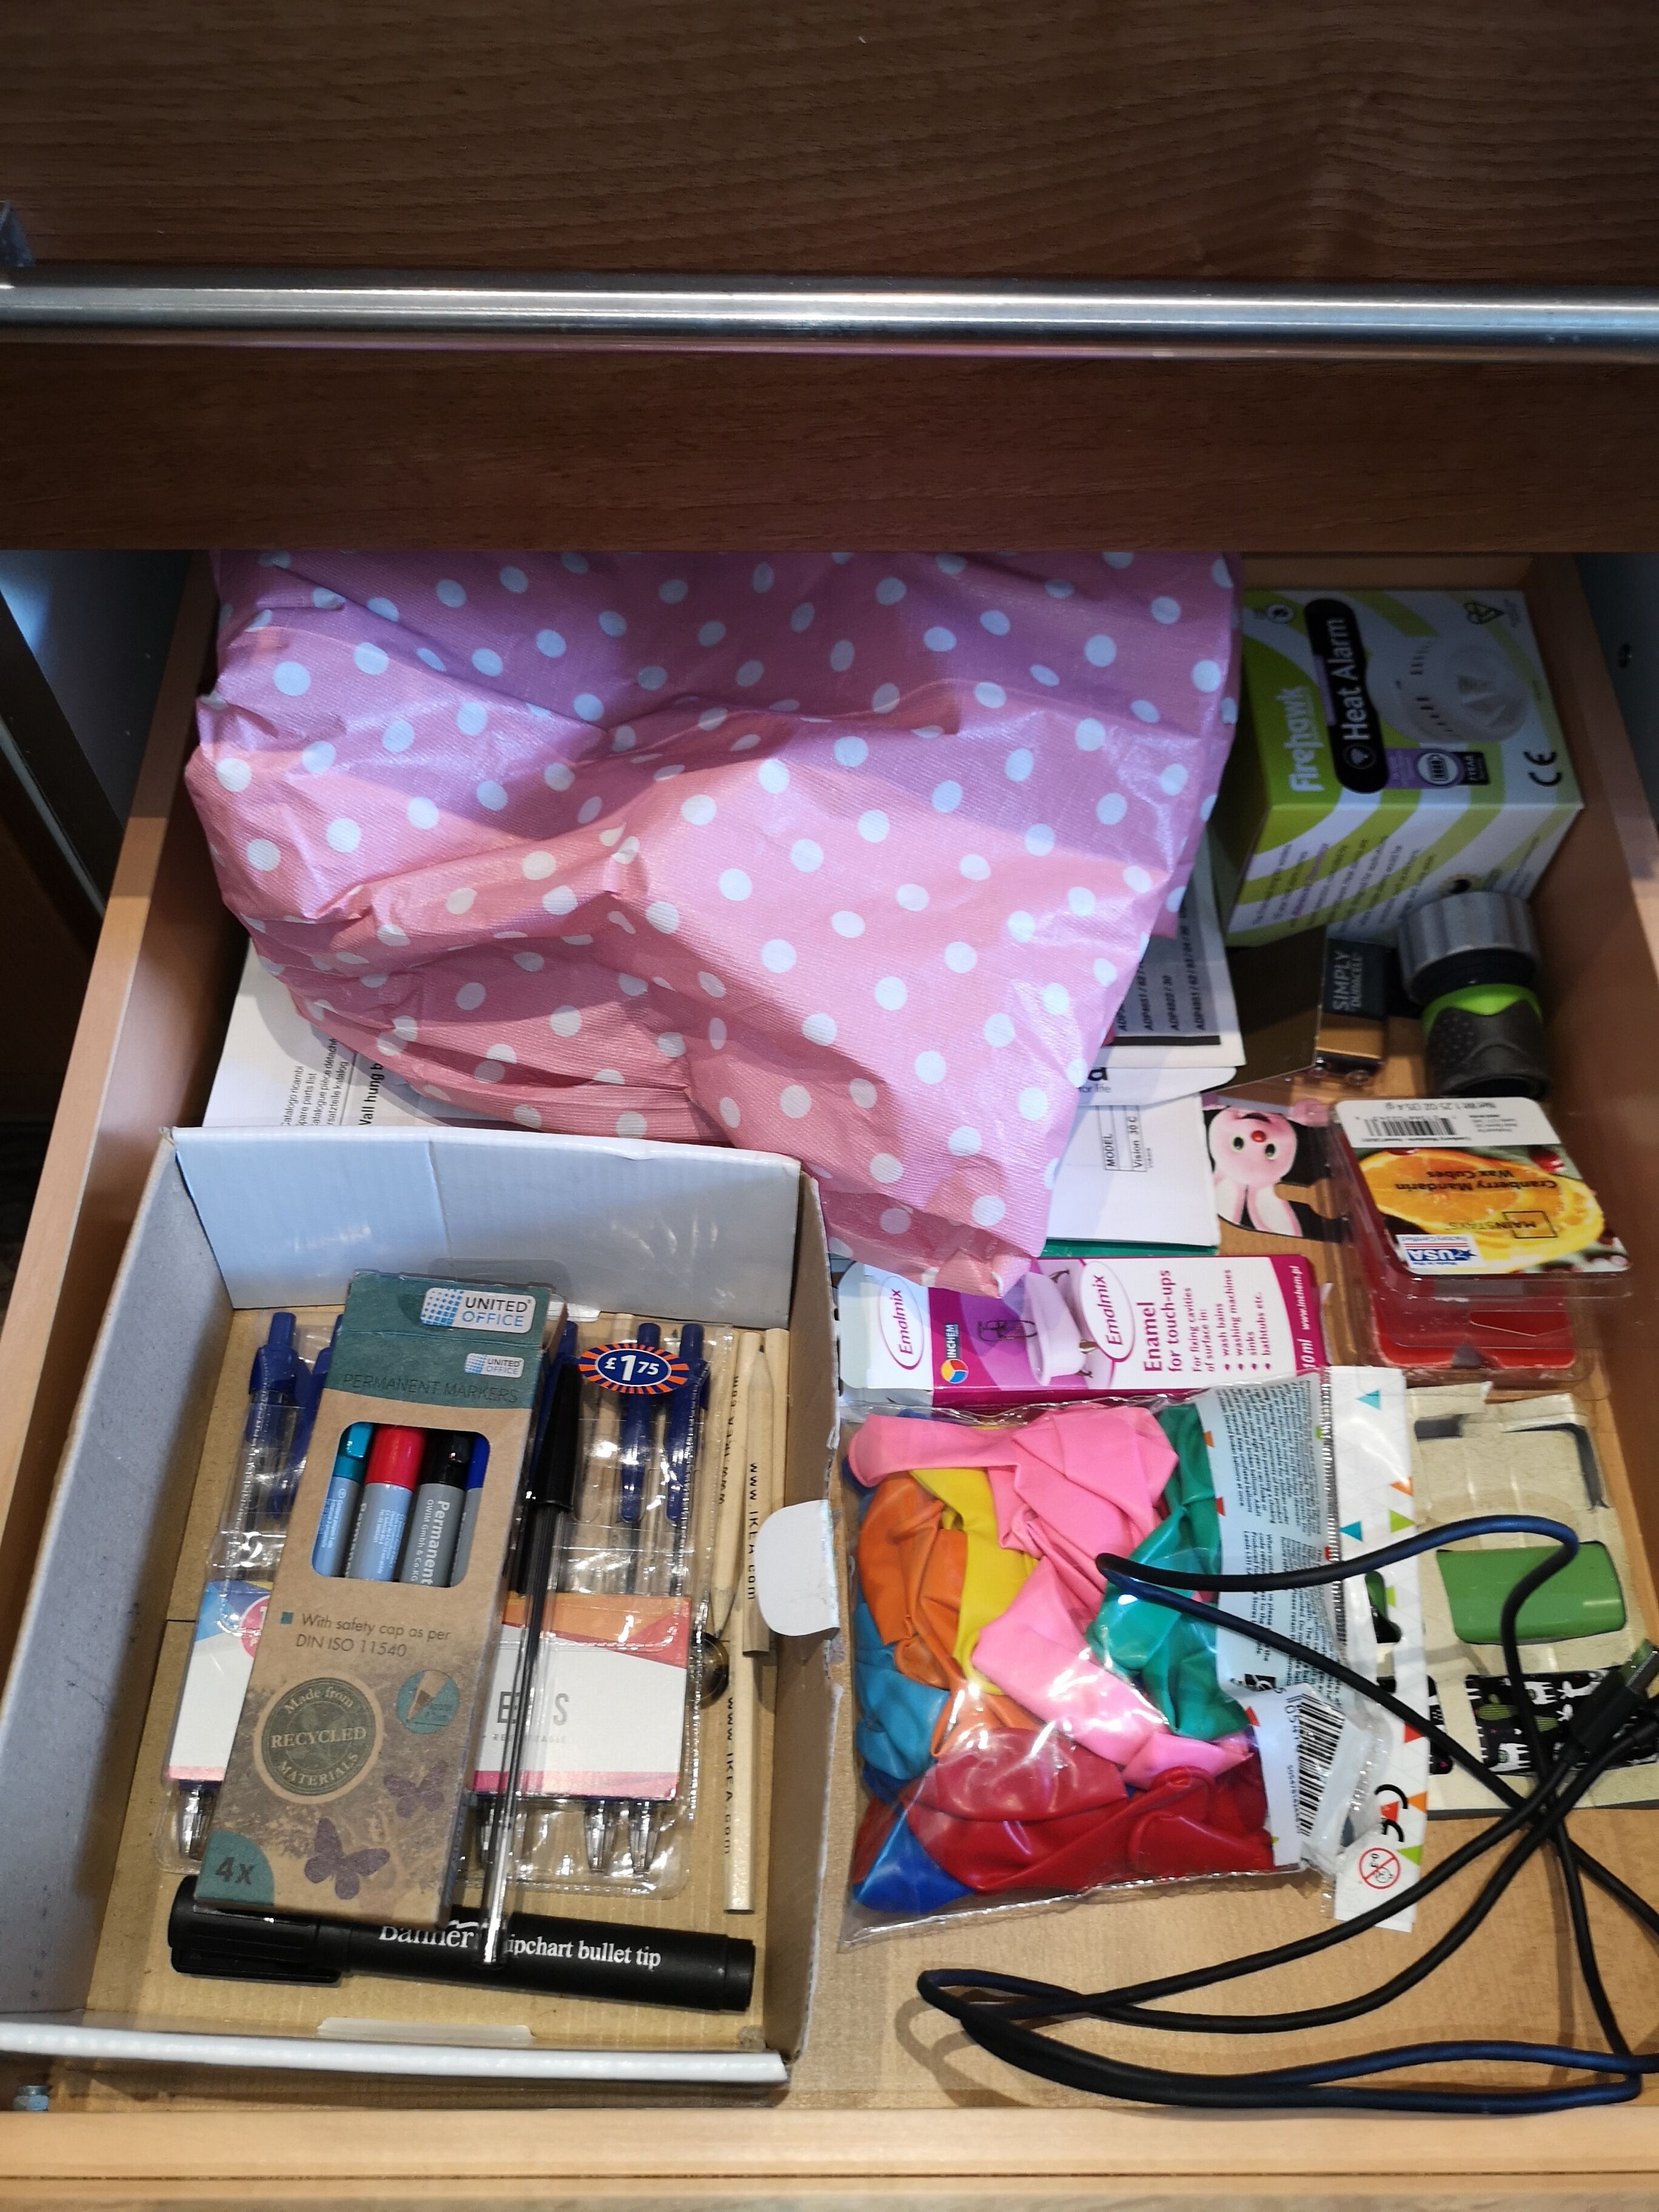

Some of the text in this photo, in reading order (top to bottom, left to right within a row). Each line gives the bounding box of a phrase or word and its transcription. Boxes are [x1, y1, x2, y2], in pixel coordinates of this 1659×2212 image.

[1327, 618, 1371, 740] Heat Alarm
[1276, 685, 1324, 792] Firehawk
[1332, 950, 1350, 1011] SIMPLY
[290, 1066, 304, 1093] ricambi
[306, 1073, 317, 1084] list
[333, 1061, 349, 1089] katalog
[363, 1073, 385, 1102] hung
[303, 1086, 314, 1105] parts
[312, 1092, 327, 1125] atalogue
[1127, 1125, 1139, 1134] 30
[1101, 1134, 1116, 1167] MODEL
[1132, 1141, 1143, 1168] Vision
[1395, 1180, 1557, 1191] Cranberry Mandarin
[1427, 1170, 1513, 1180] Wax Cubes
[1407, 1249, 1454, 1261] USA
[466, 1297, 528, 1313] UNITED
[1092, 1275, 1123, 1346] Emalmix
[1289, 1265, 1310, 1330] www.inchem.pl
[462, 1311, 524, 1327] OFFICE
[890, 1289, 914, 1355] Emalmix
[1159, 1270, 1182, 1372] for touch-ups
[1224, 1269, 1244, 1356] washing machines
[1255, 1292, 1271, 1355] bathtubs etc.
[945, 1324, 957, 1358] INCHEM
[1136, 1302, 1162, 1372] Enamel
[1183, 1287, 1202, 1372] For fixing cavities
[1199, 1309, 1215, 1372] of surface in:
[1218, 1332, 1230, 1356] wash
[1246, 1331, 1258, 1356] sinks
[1297, 1338, 1314, 1352] ml
[488, 1358, 520, 1367] UNITED
[1301, 1355, 1316, 1368] 10
[343, 1373, 518, 1403] PERMANENT MARKERS
[1247, 1447, 1255, 1468] broken
[1259, 1443, 1268, 1458] parts
[1232, 1456, 1241, 1481] balloons
[1240, 1453, 1250, 1484] uninflated
[1262, 1460, 1272, 1492] presenting
[423, 1499, 434, 1523] OWIM
[1273, 1498, 1282, 1524] product
[417, 1524, 429, 1548] Gmbh
[420, 1500, 451, 1585] Permanent
[302, 1613, 451, 1642] With safety cap as per
[296, 1634, 407, 1657] DIN ISO 11540
[284, 1684, 354, 1714] Made from
[270, 1726, 367, 1749] RECYCLED
[277, 1752, 358, 1789] MATERIALS
[215, 1856, 254, 1885] 4x
[577, 1939, 631, 1963] bullet
[635, 1945, 662, 1971] tip
